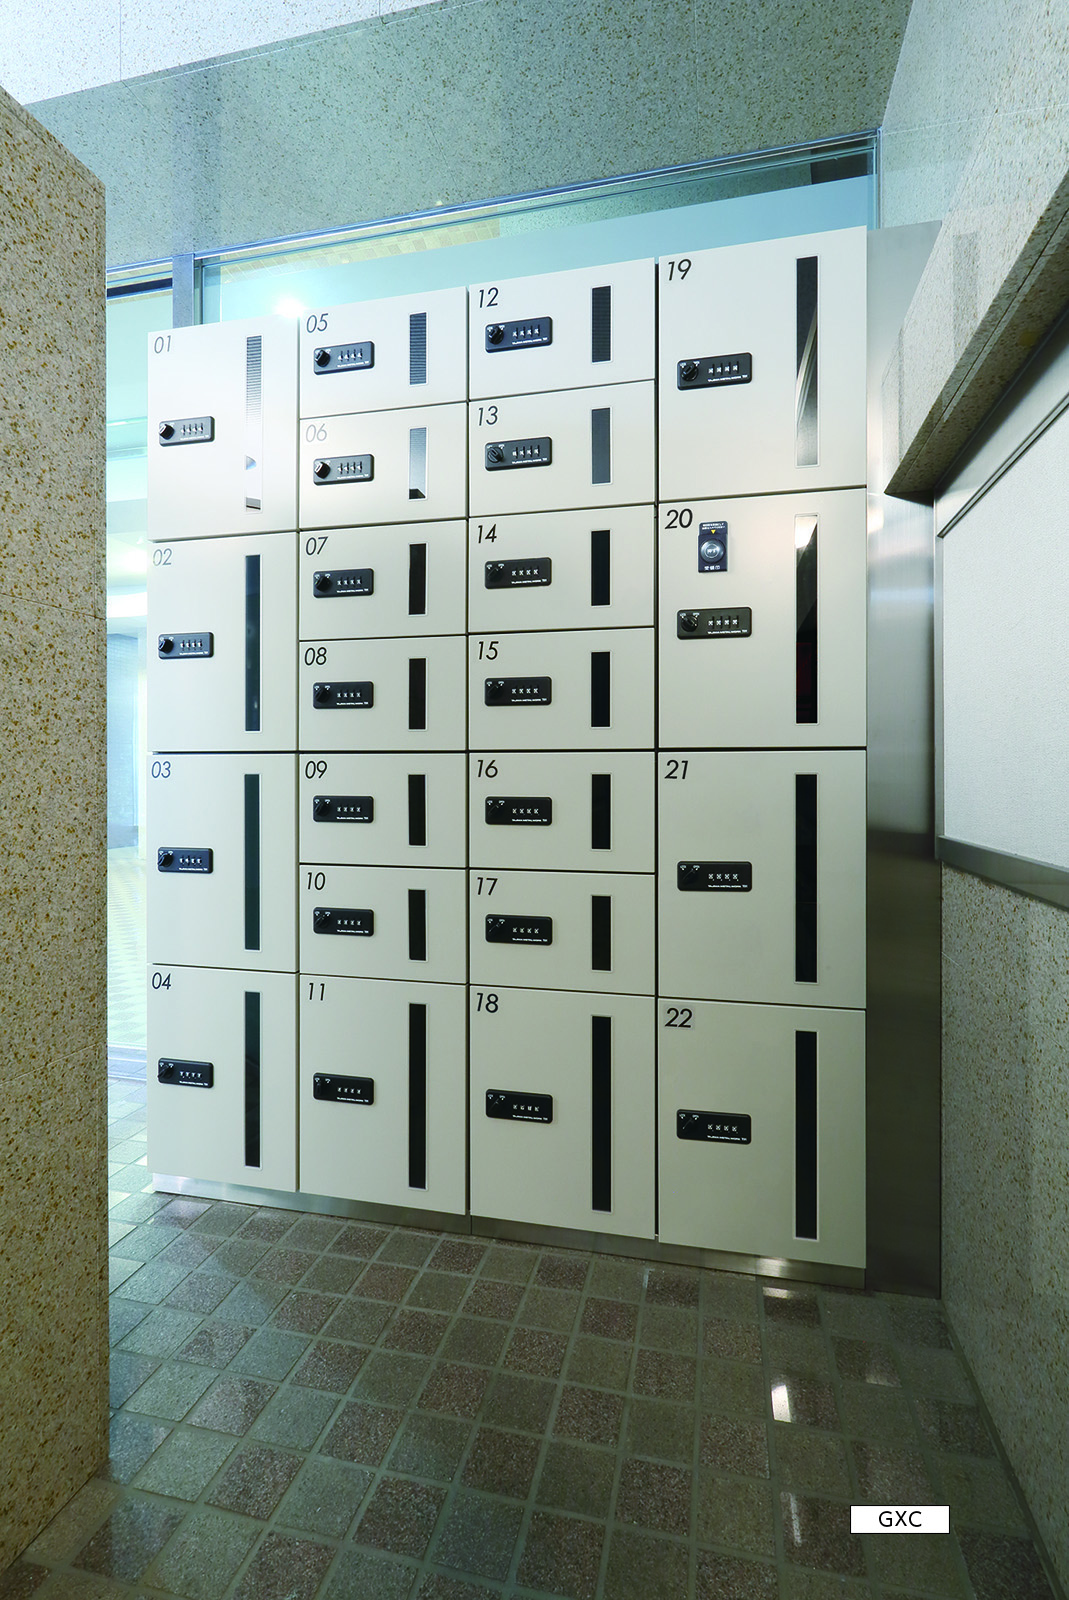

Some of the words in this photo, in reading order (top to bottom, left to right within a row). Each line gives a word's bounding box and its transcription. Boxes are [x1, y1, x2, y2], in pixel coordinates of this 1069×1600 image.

[668, 259, 691, 280] 19
[480, 287, 498, 308] 12
[307, 313, 328, 333] 05
[154, 335, 171, 354] 01
[479, 406, 498, 426] 13
[305, 424, 327, 442] 06
[665, 509, 693, 529] 20
[478, 524, 497, 543] 14
[306, 537, 328, 555] 07
[153, 548, 172, 566] 02
[305, 647, 327, 665] 08
[479, 641, 499, 660] 15
[152, 761, 171, 778] 03
[305, 761, 327, 779] 09
[478, 760, 498, 778] 16
[665, 760, 688, 779] 21
[308, 872, 325, 890] 10
[478, 877, 497, 895] 17
[152, 972, 171, 990] 04
[309, 983, 326, 1001] 11
[477, 993, 498, 1013] 18
[665, 1008, 692, 1028] 22
